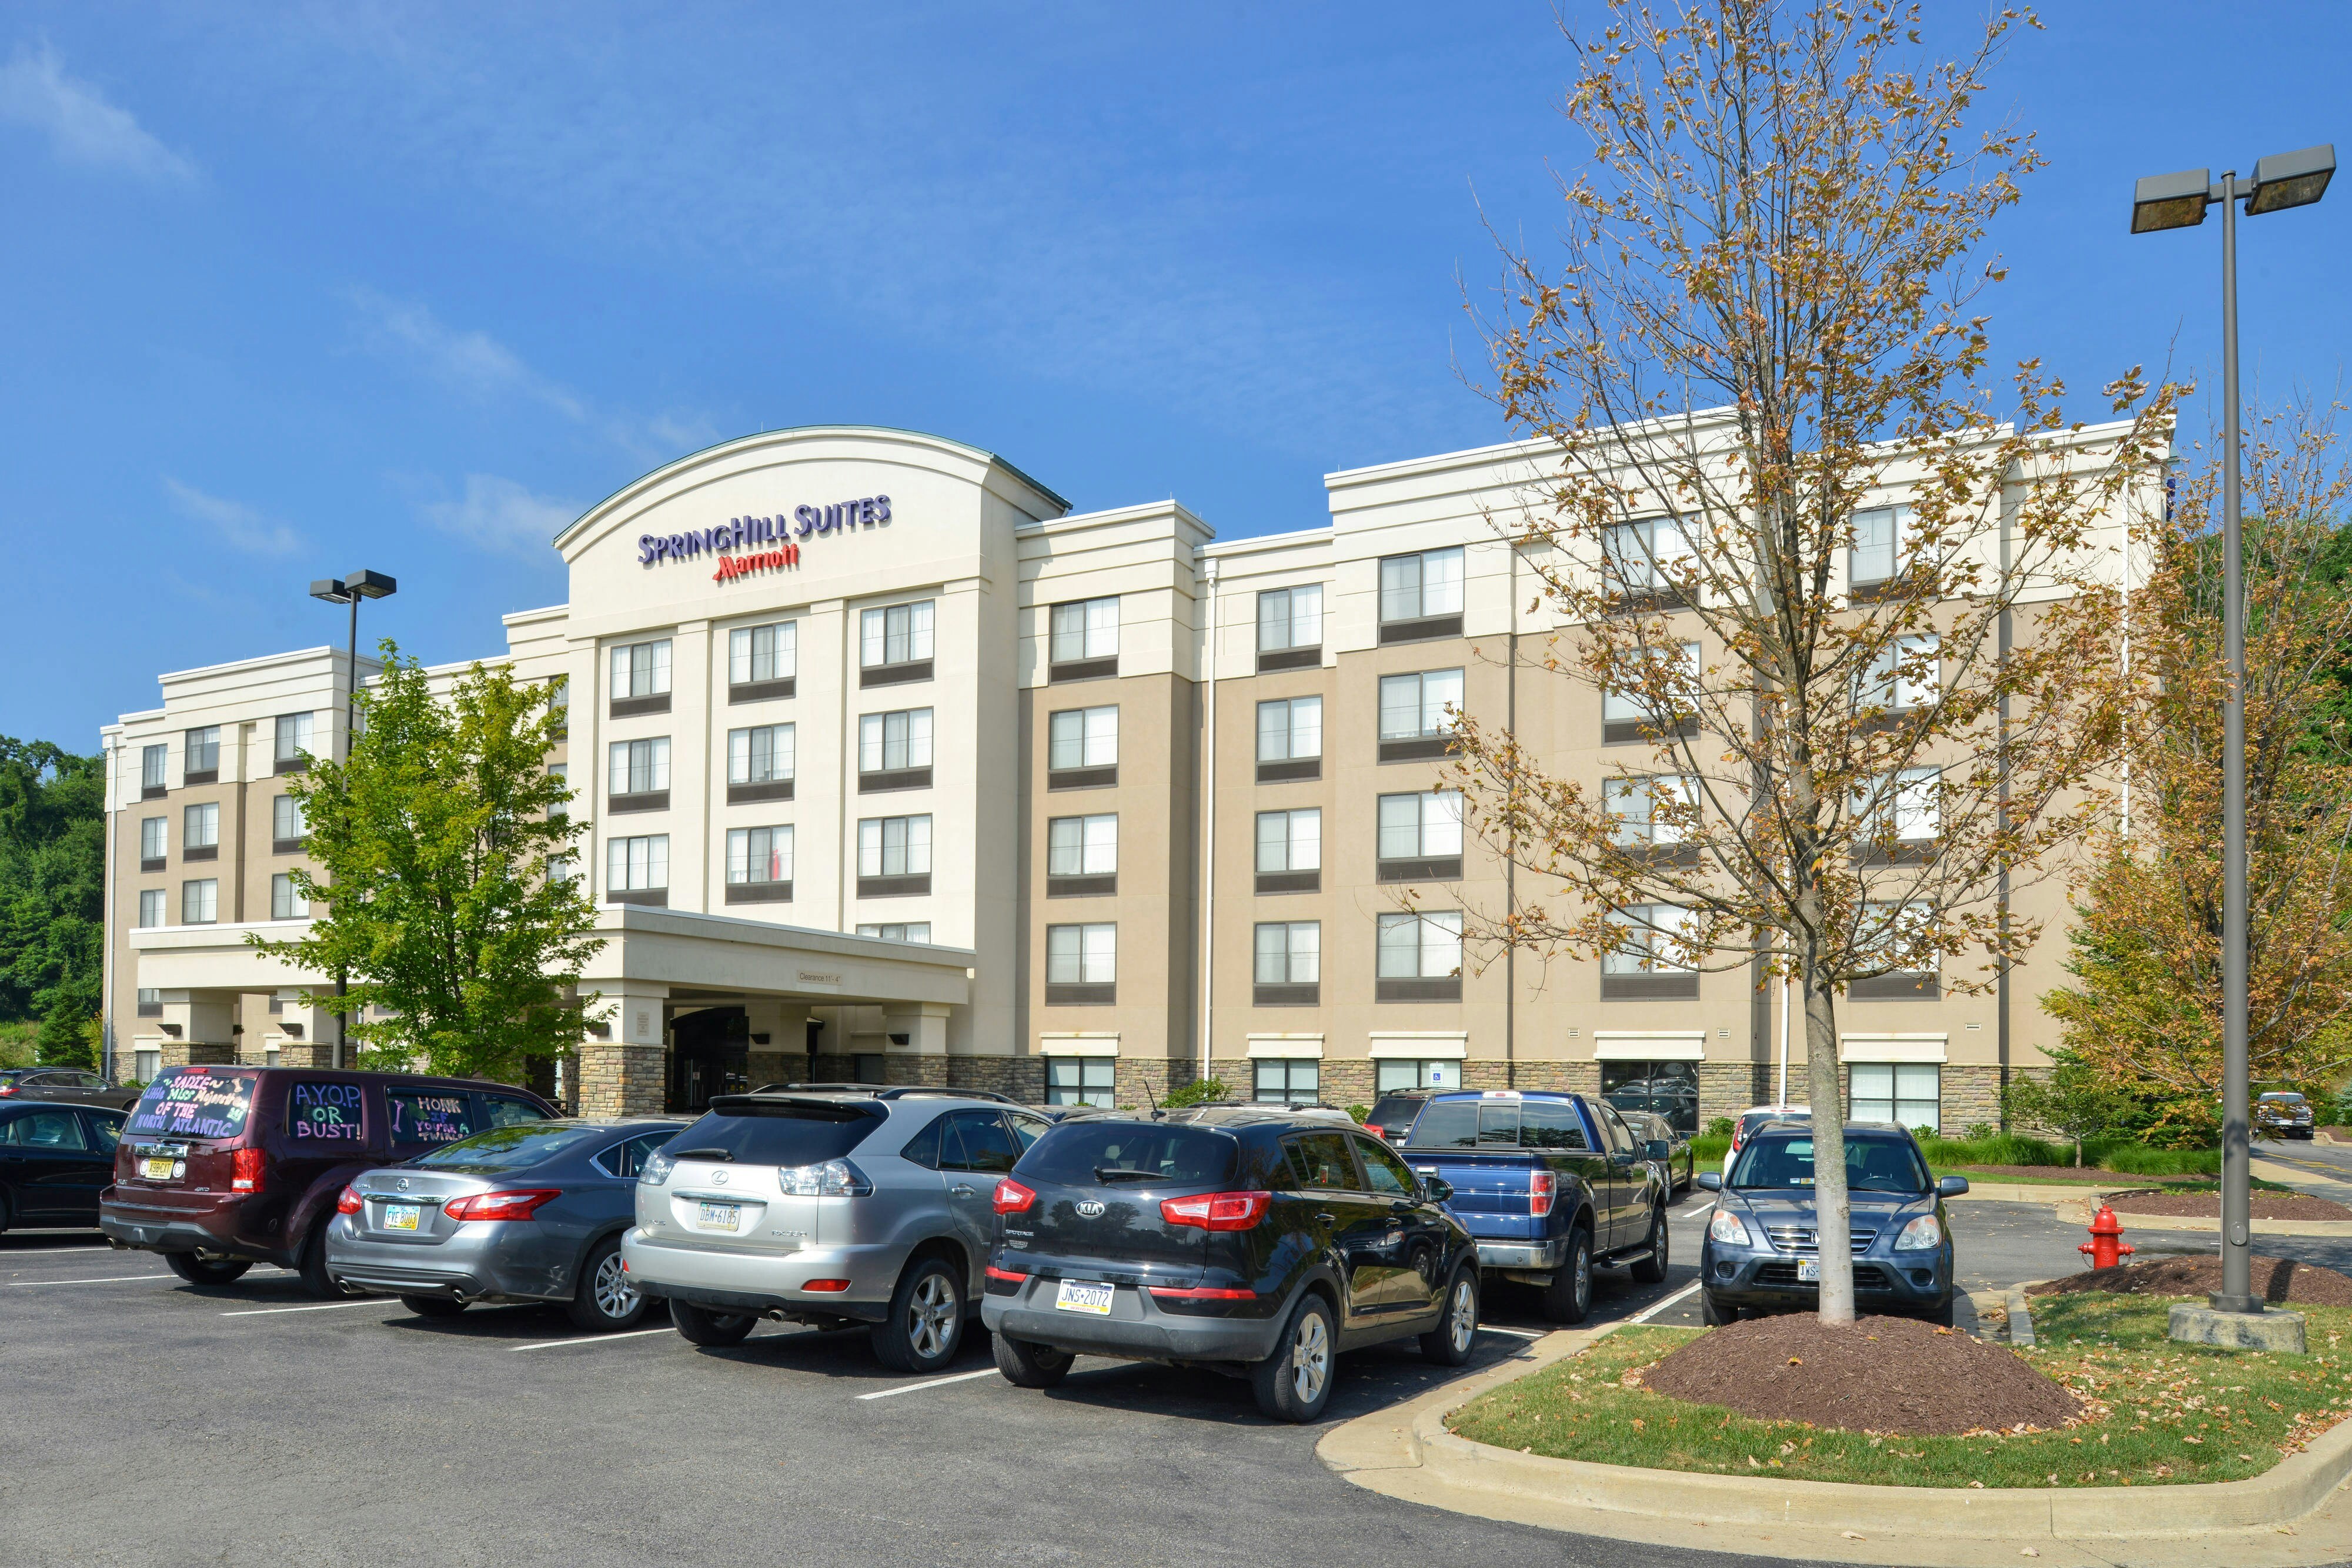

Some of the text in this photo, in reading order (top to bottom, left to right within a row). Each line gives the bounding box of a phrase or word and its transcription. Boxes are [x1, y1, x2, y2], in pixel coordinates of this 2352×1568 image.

[637, 494, 891, 564] SPRINGHILL SUITES
[712, 543, 800, 581] Marriott
[800, 972, 824, 982] Clearance
[170, 1075, 212, 1091] SADIE
[155, 1101, 199, 1119] OF THE
[417, 1096, 462, 1114] HONK
[312, 1106, 343, 1124] OR
[430, 1112, 449, 1123] IF
[135, 1114, 233, 1137] NORTH ATLANTIC
[297, 1121, 361, 1141] BUST!
[460, 1122, 470, 1135] A
[387, 1211, 416, 1224] FVE 8003
[1080, 1203, 1100, 1214] KIA
